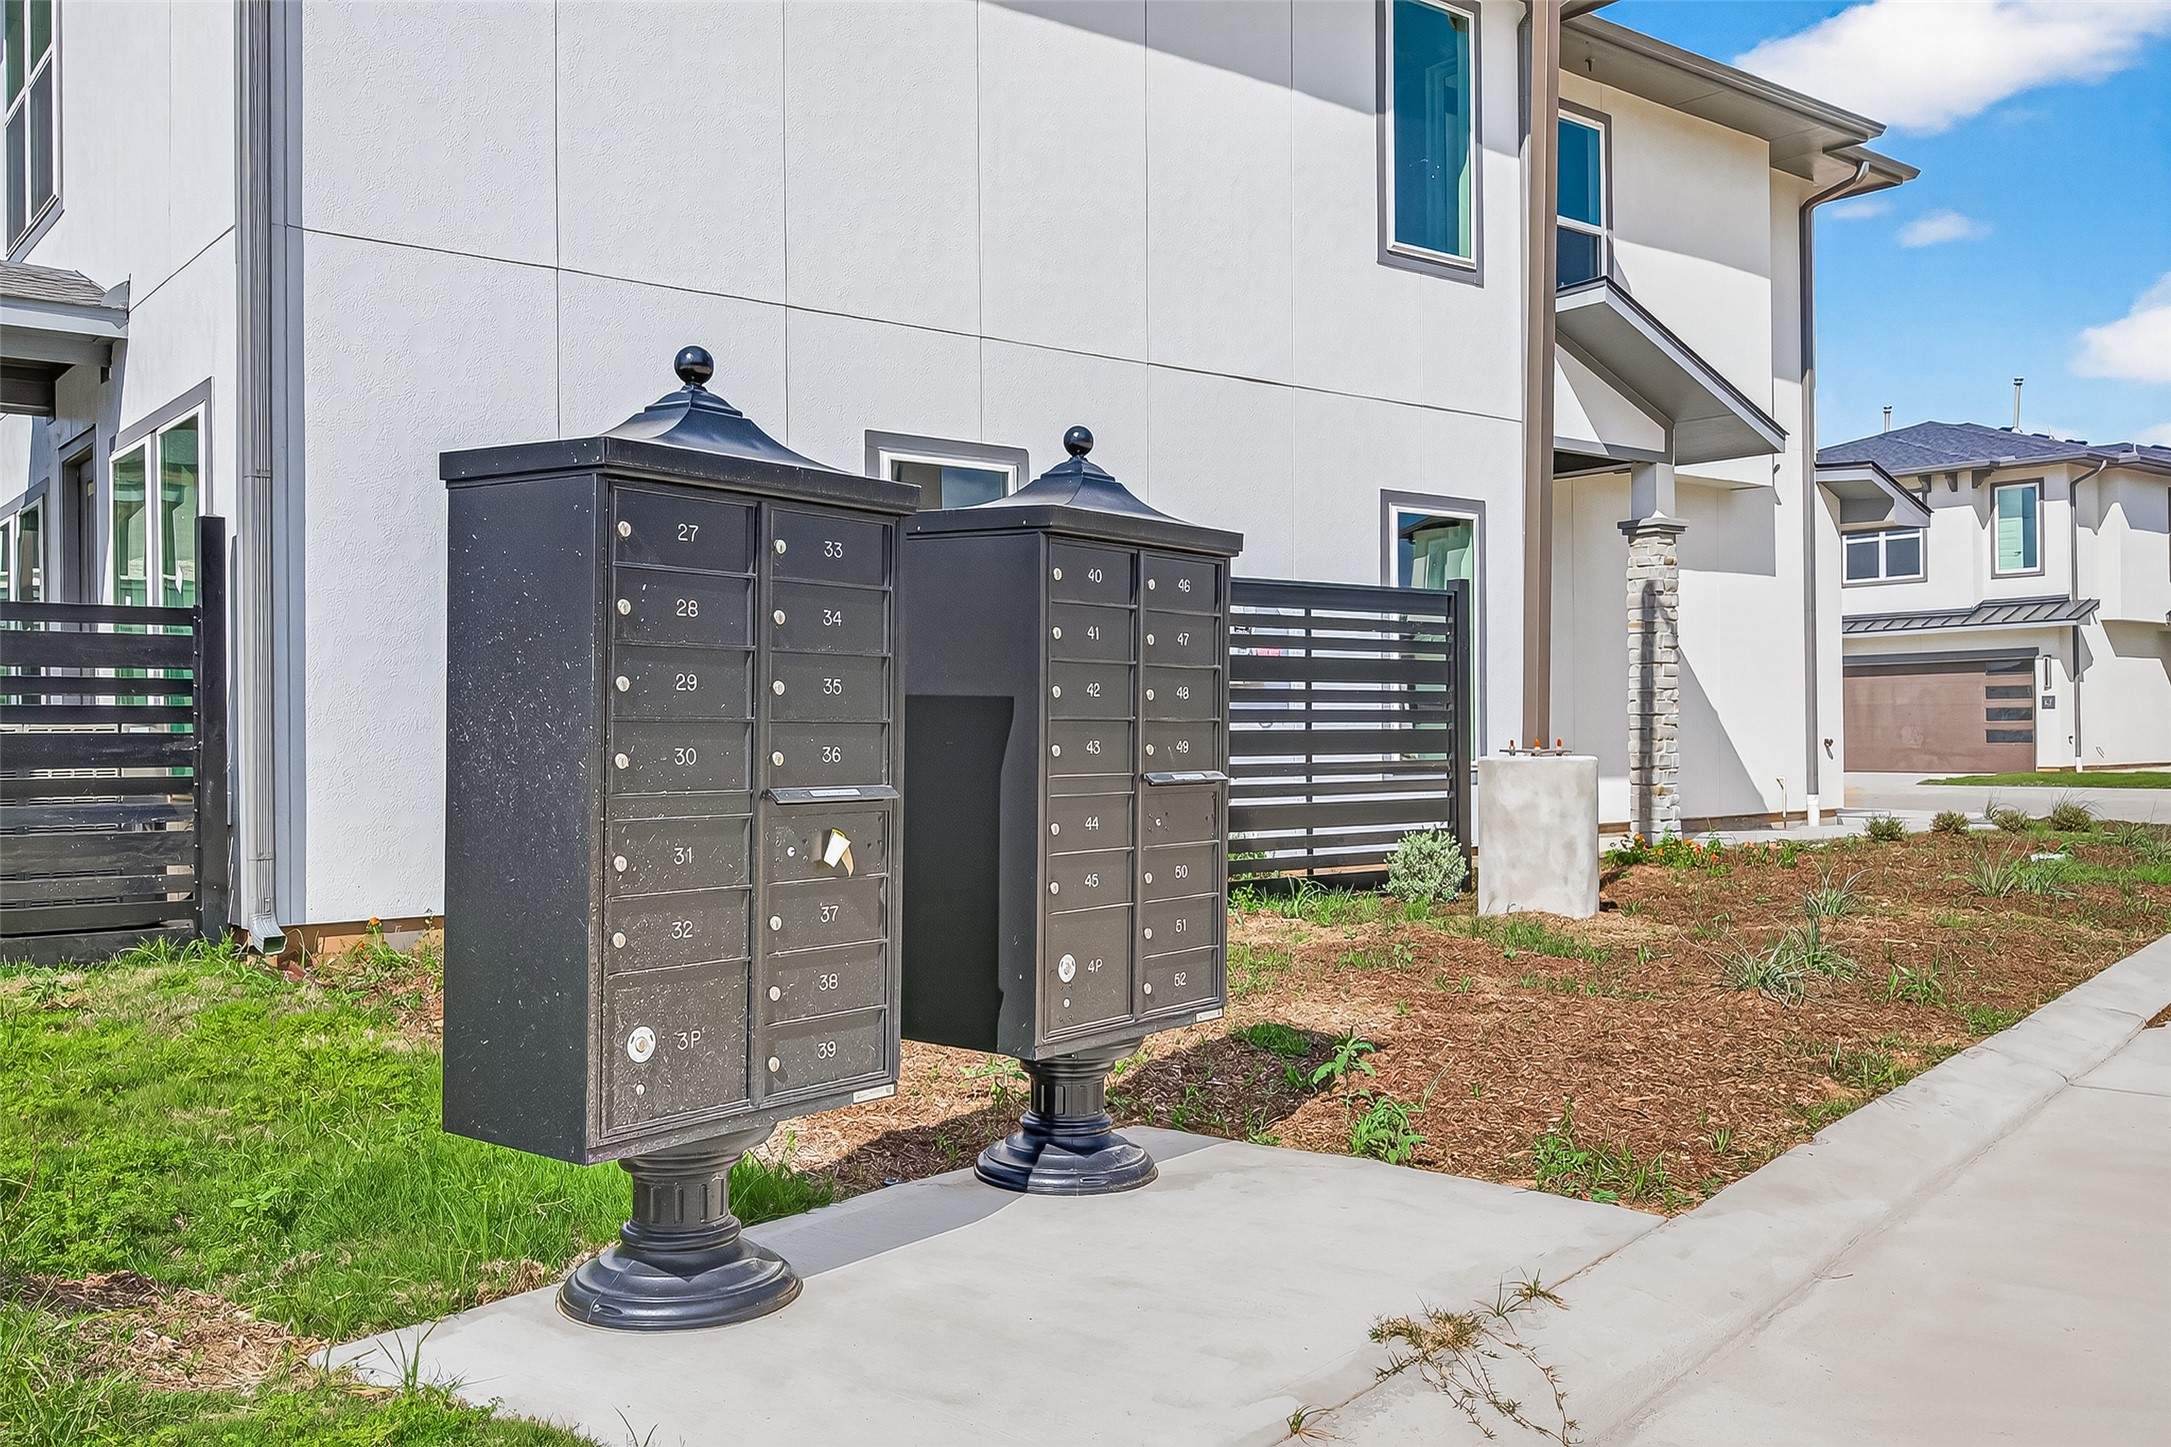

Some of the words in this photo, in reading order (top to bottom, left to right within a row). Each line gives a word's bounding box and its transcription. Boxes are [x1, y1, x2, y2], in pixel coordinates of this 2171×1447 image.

[677, 522, 700, 543] 27
[823, 540, 844, 559] 33
[1087, 569, 1103, 584] 40
[1177, 579, 1192, 593] 46
[675, 598, 699, 618] 28
[822, 609, 843, 627] 34
[1086, 626, 1100, 641] 41
[1176, 633, 1190, 647] 47
[674, 672, 698, 692] 29
[1086, 683, 1101, 698] 42
[1176, 687, 1190, 700] 48
[673, 747, 698, 766] 30
[821, 745, 842, 764] 36
[1085, 740, 1101, 756] 43
[1175, 741, 1190, 754] 49
[1084, 816, 1100, 831] 44
[672, 845, 694, 866] 31
[819, 904, 840, 923] 37
[670, 919, 694, 940] 32
[1087, 959, 1104, 974] 4P
[818, 973, 839, 991] 38
[676, 1030, 702, 1051] 3P
[817, 1041, 838, 1060] 39
